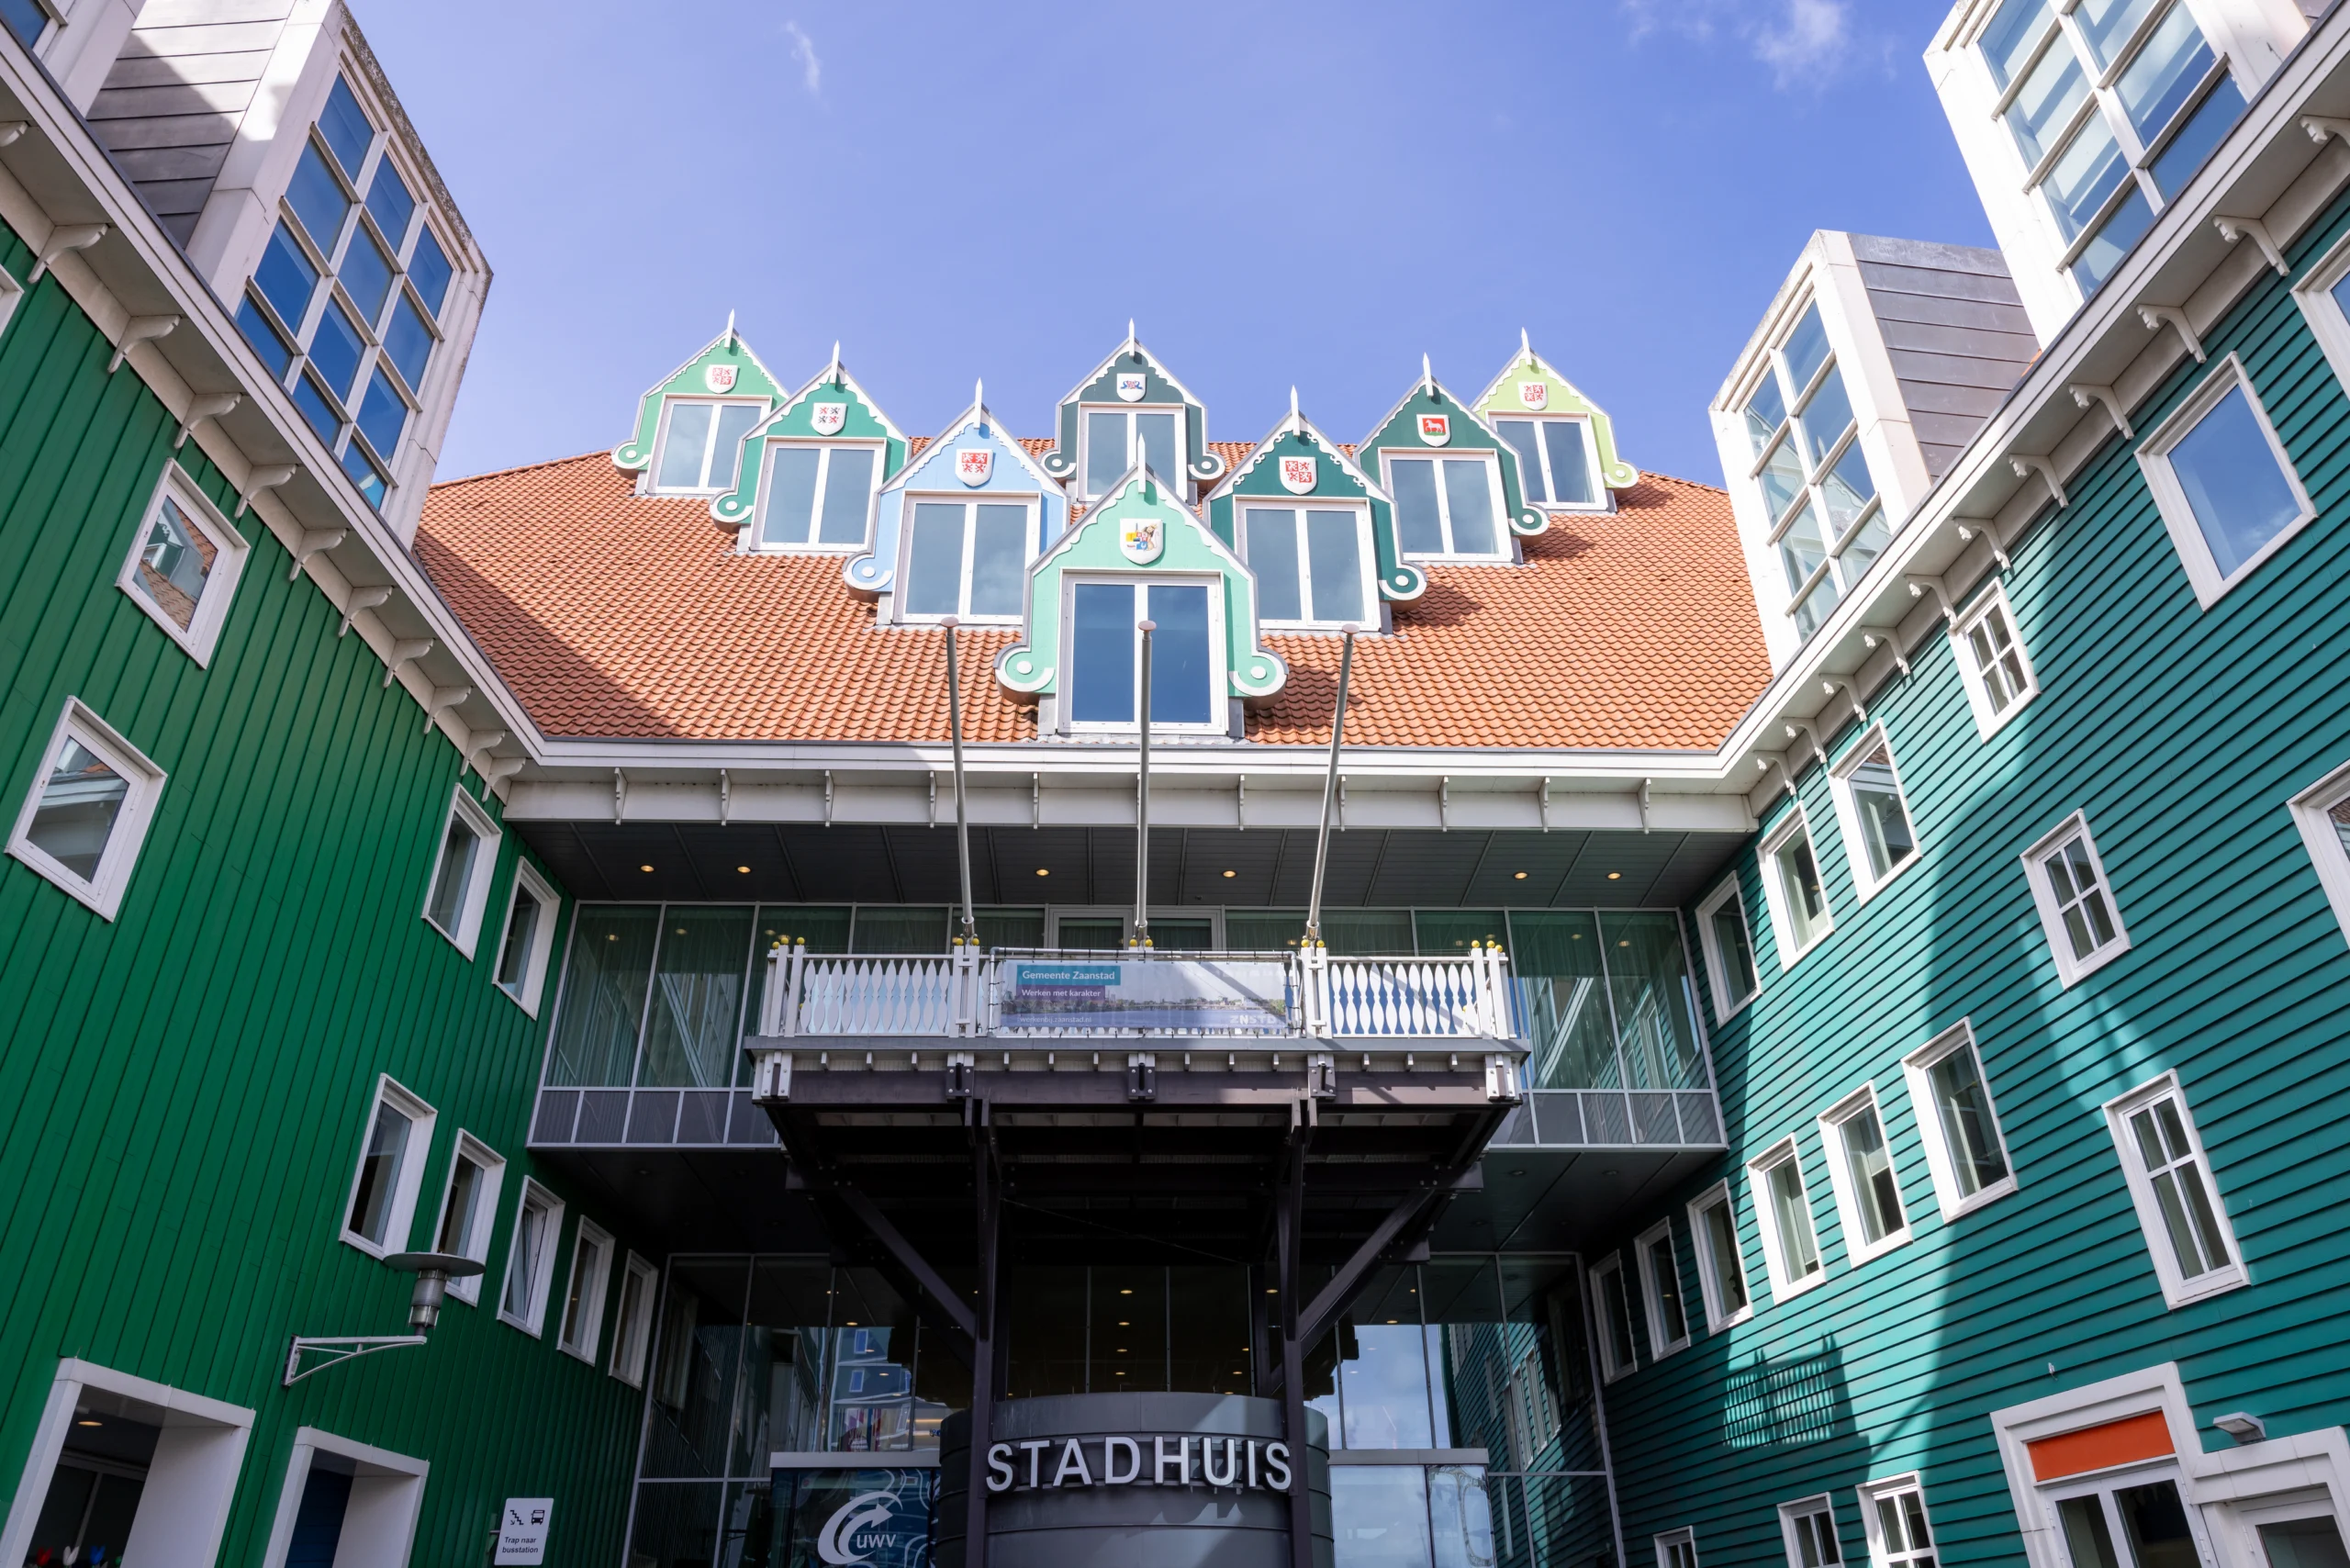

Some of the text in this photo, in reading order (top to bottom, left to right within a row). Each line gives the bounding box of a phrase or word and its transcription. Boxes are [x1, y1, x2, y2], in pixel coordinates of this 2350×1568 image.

[1022, 970, 1115, 980] Gemeente Zaanstad
[1069, 989, 1101, 997] karakter
[986, 1436, 1292, 1492] STADHUIS
[856, 1534, 896, 1548] uwv
